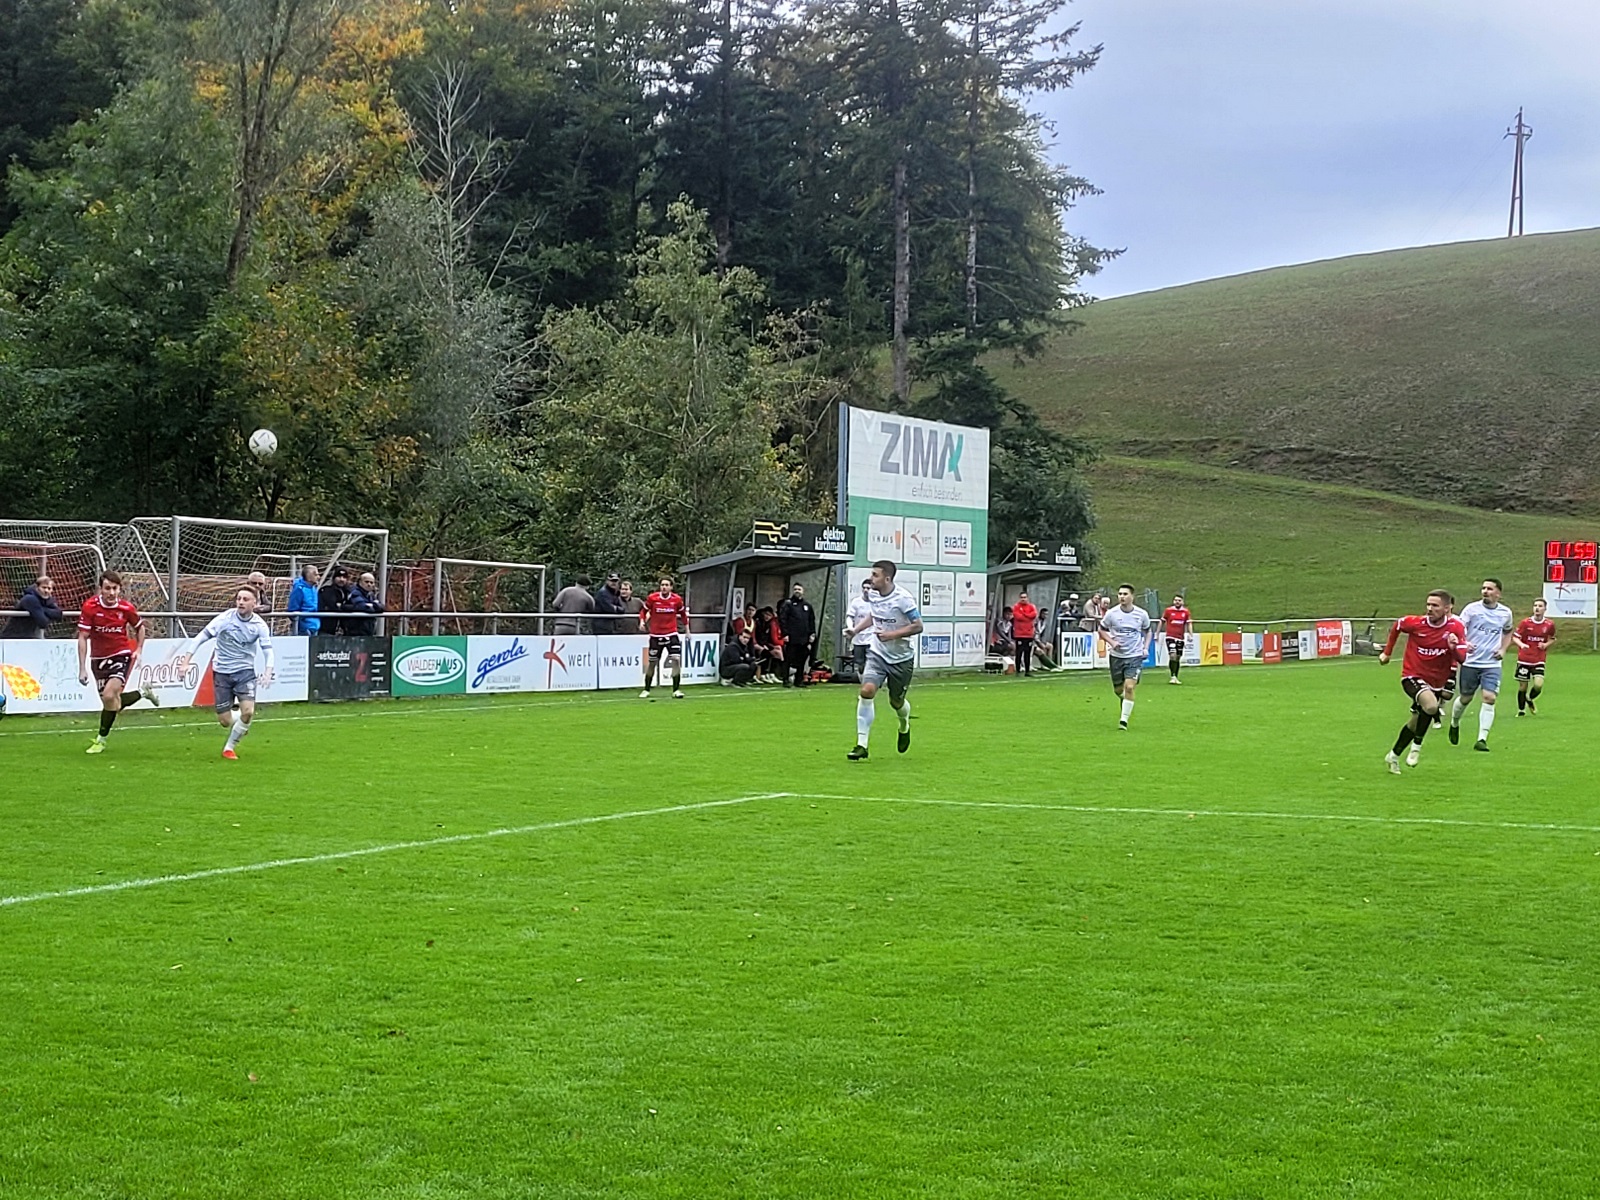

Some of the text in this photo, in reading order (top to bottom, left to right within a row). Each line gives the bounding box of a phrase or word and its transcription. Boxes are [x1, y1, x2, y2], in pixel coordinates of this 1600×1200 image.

[880, 421, 963, 482] ZIMA
[823, 526, 845, 540] elektro
[815, 536, 848, 551] kirchmann
[472, 636, 528, 689] gerola
[567, 652, 591, 667] wert
